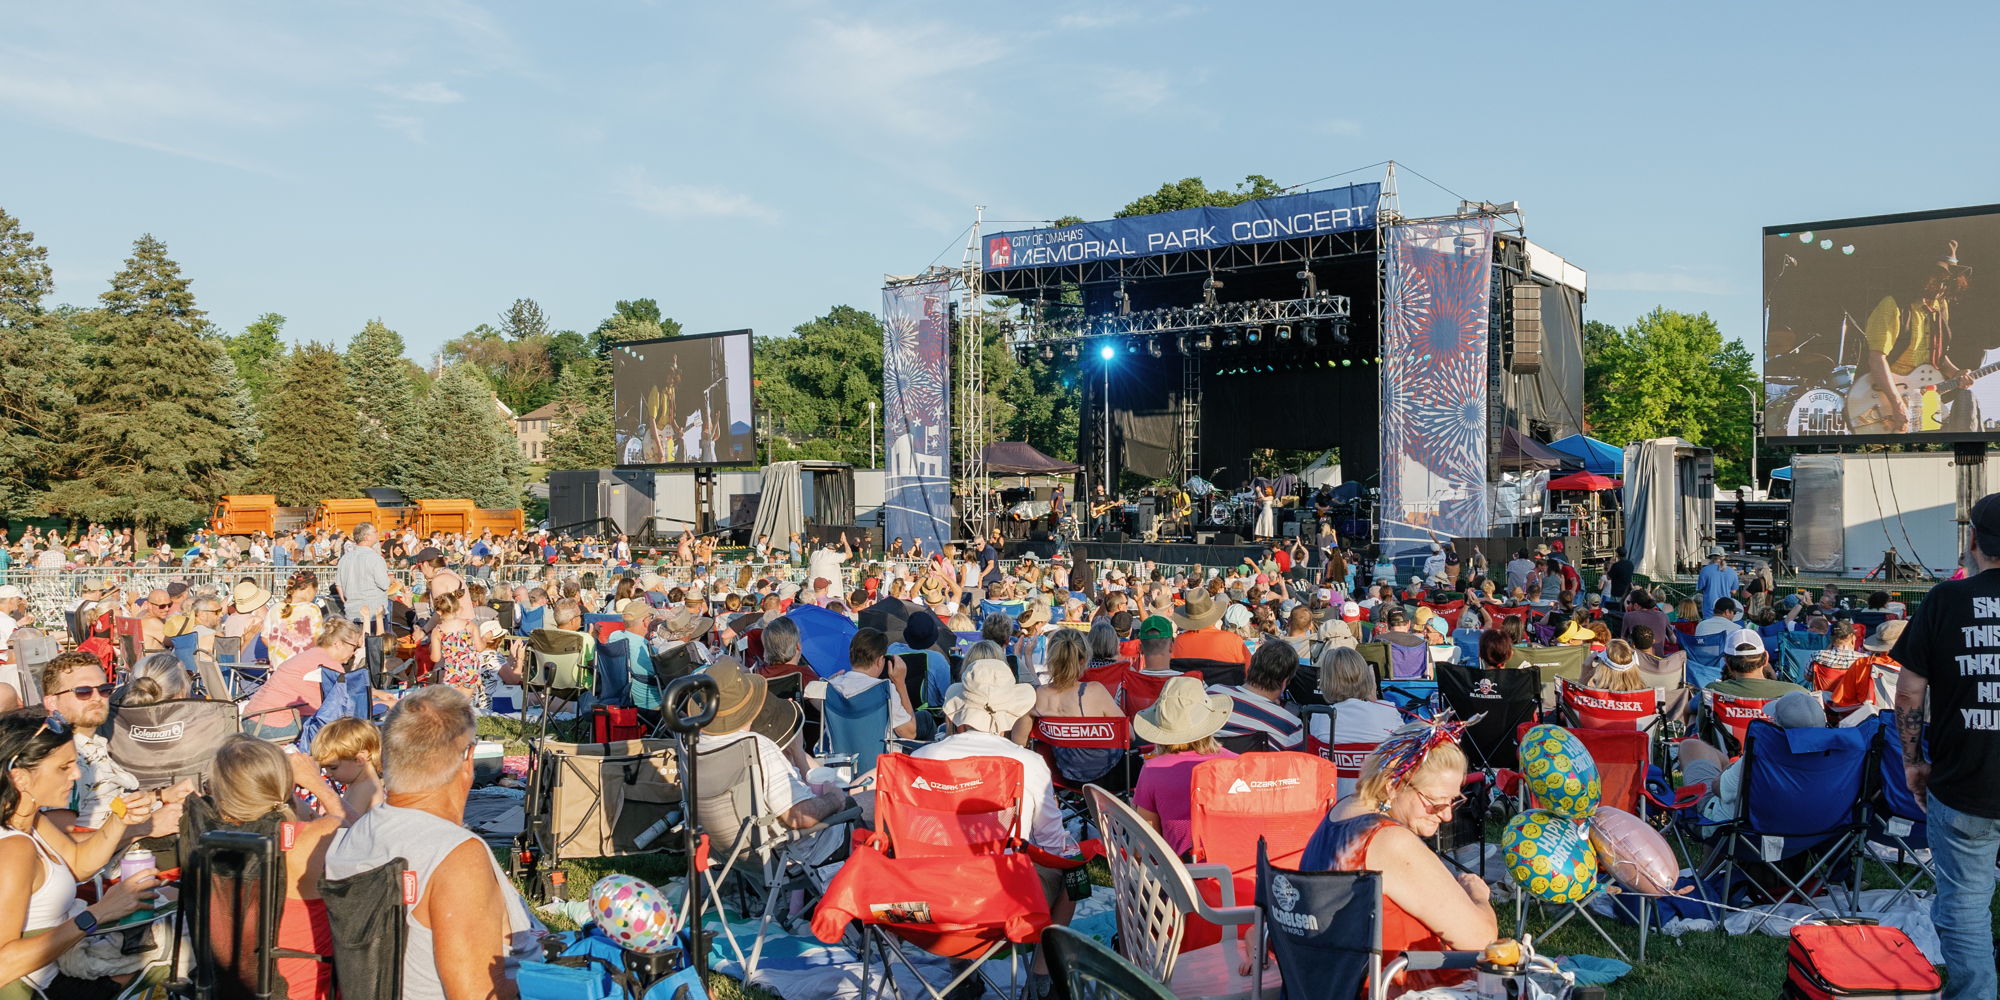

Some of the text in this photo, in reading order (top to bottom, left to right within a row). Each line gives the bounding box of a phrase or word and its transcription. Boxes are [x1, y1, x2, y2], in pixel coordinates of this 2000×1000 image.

[1013, 229, 1083, 248] CITY OF OMAHA'S
[1014, 205, 1369, 265] MEMORIAL PARK CONCERT
[1809, 392, 1839, 403] GRETSCH
[1574, 695, 1643, 712] NEBRASKA
[133, 727, 172, 738] Coleman
